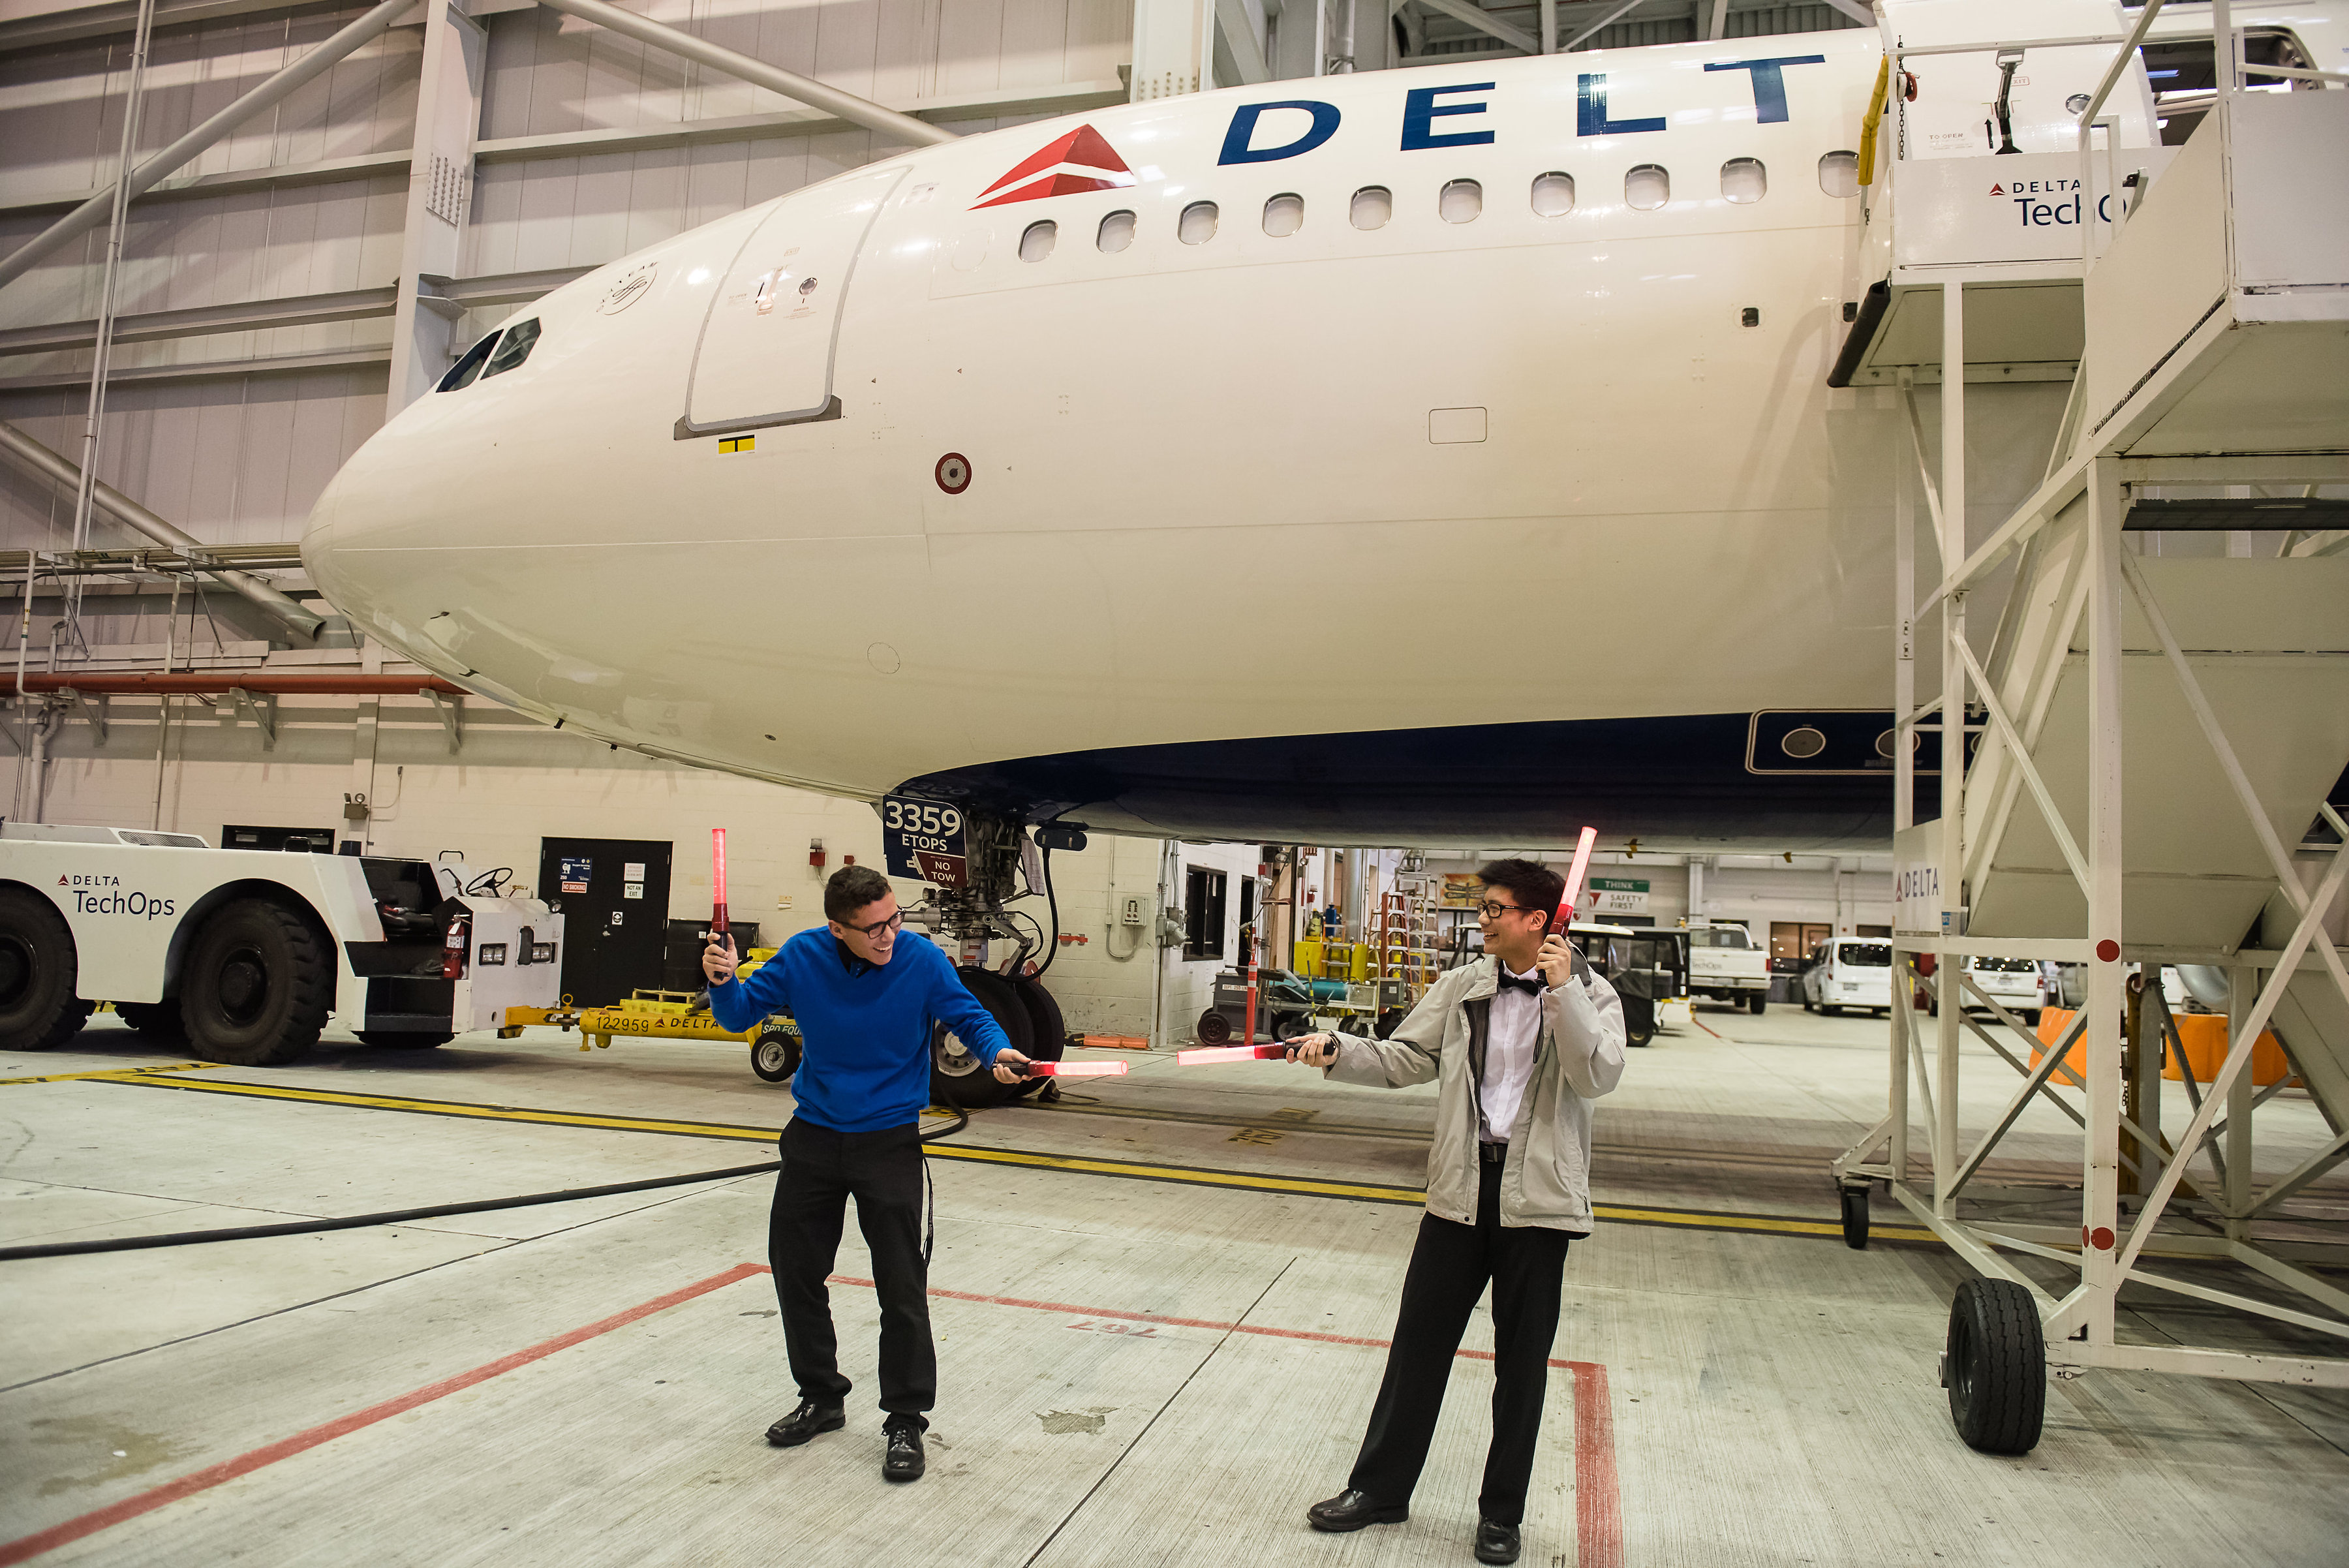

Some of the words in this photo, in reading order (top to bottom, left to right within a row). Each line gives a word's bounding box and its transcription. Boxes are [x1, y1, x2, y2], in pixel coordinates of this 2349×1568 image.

[1217, 55, 1826, 165] DELT
[2013, 179, 2080, 193] DELTA
[886, 801, 960, 837] 3359
[902, 833, 947, 851] ETOPS
[935, 861, 950, 870] NO
[73, 875, 120, 886] DELTA
[931, 871, 955, 882] TOW
[1605, 880, 1633, 889] THINK
[1905, 868, 1939, 898] DELTA
[73, 890, 175, 921] TechOps
[596, 1017, 649, 1032] 122959
[671, 1018, 718, 1028] DELTA
[1066, 1321, 1158, 1338] 767
